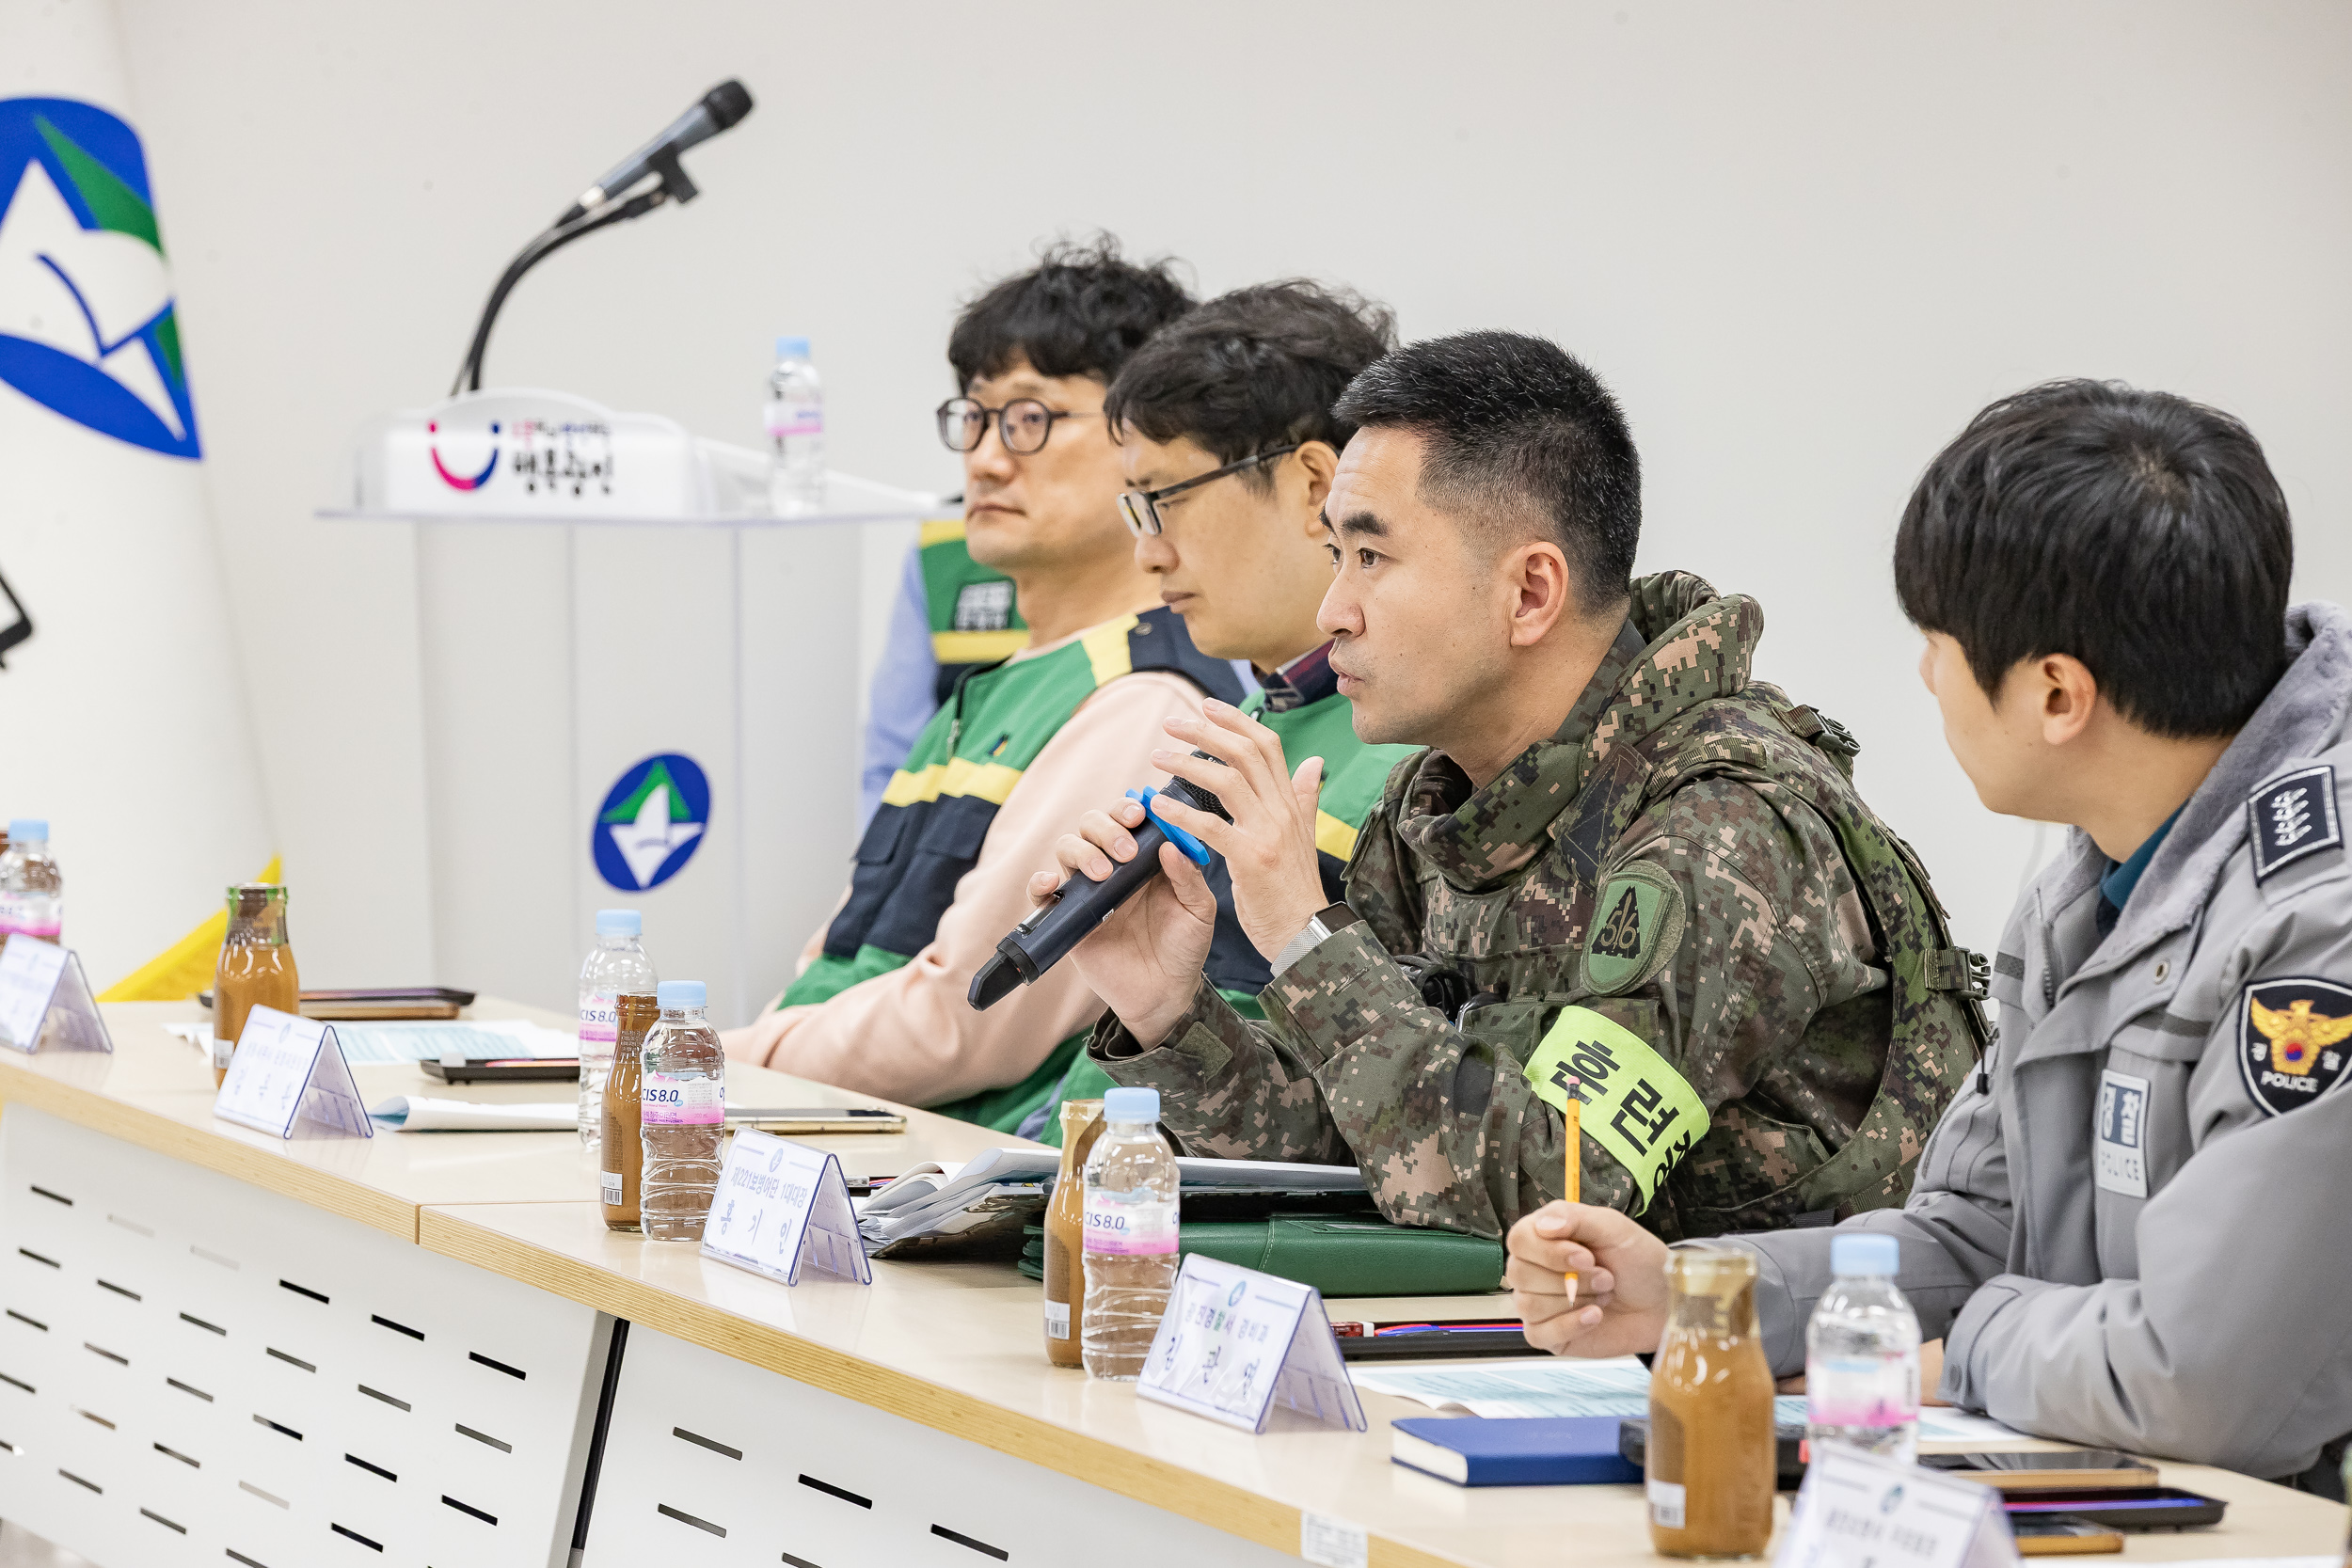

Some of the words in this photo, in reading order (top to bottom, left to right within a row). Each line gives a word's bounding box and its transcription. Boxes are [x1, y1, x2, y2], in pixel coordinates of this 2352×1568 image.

[1600, 910, 1637, 949] 56
[2261, 1070, 2319, 1093] POLICE
[2104, 1085, 2140, 1147] 경찰
